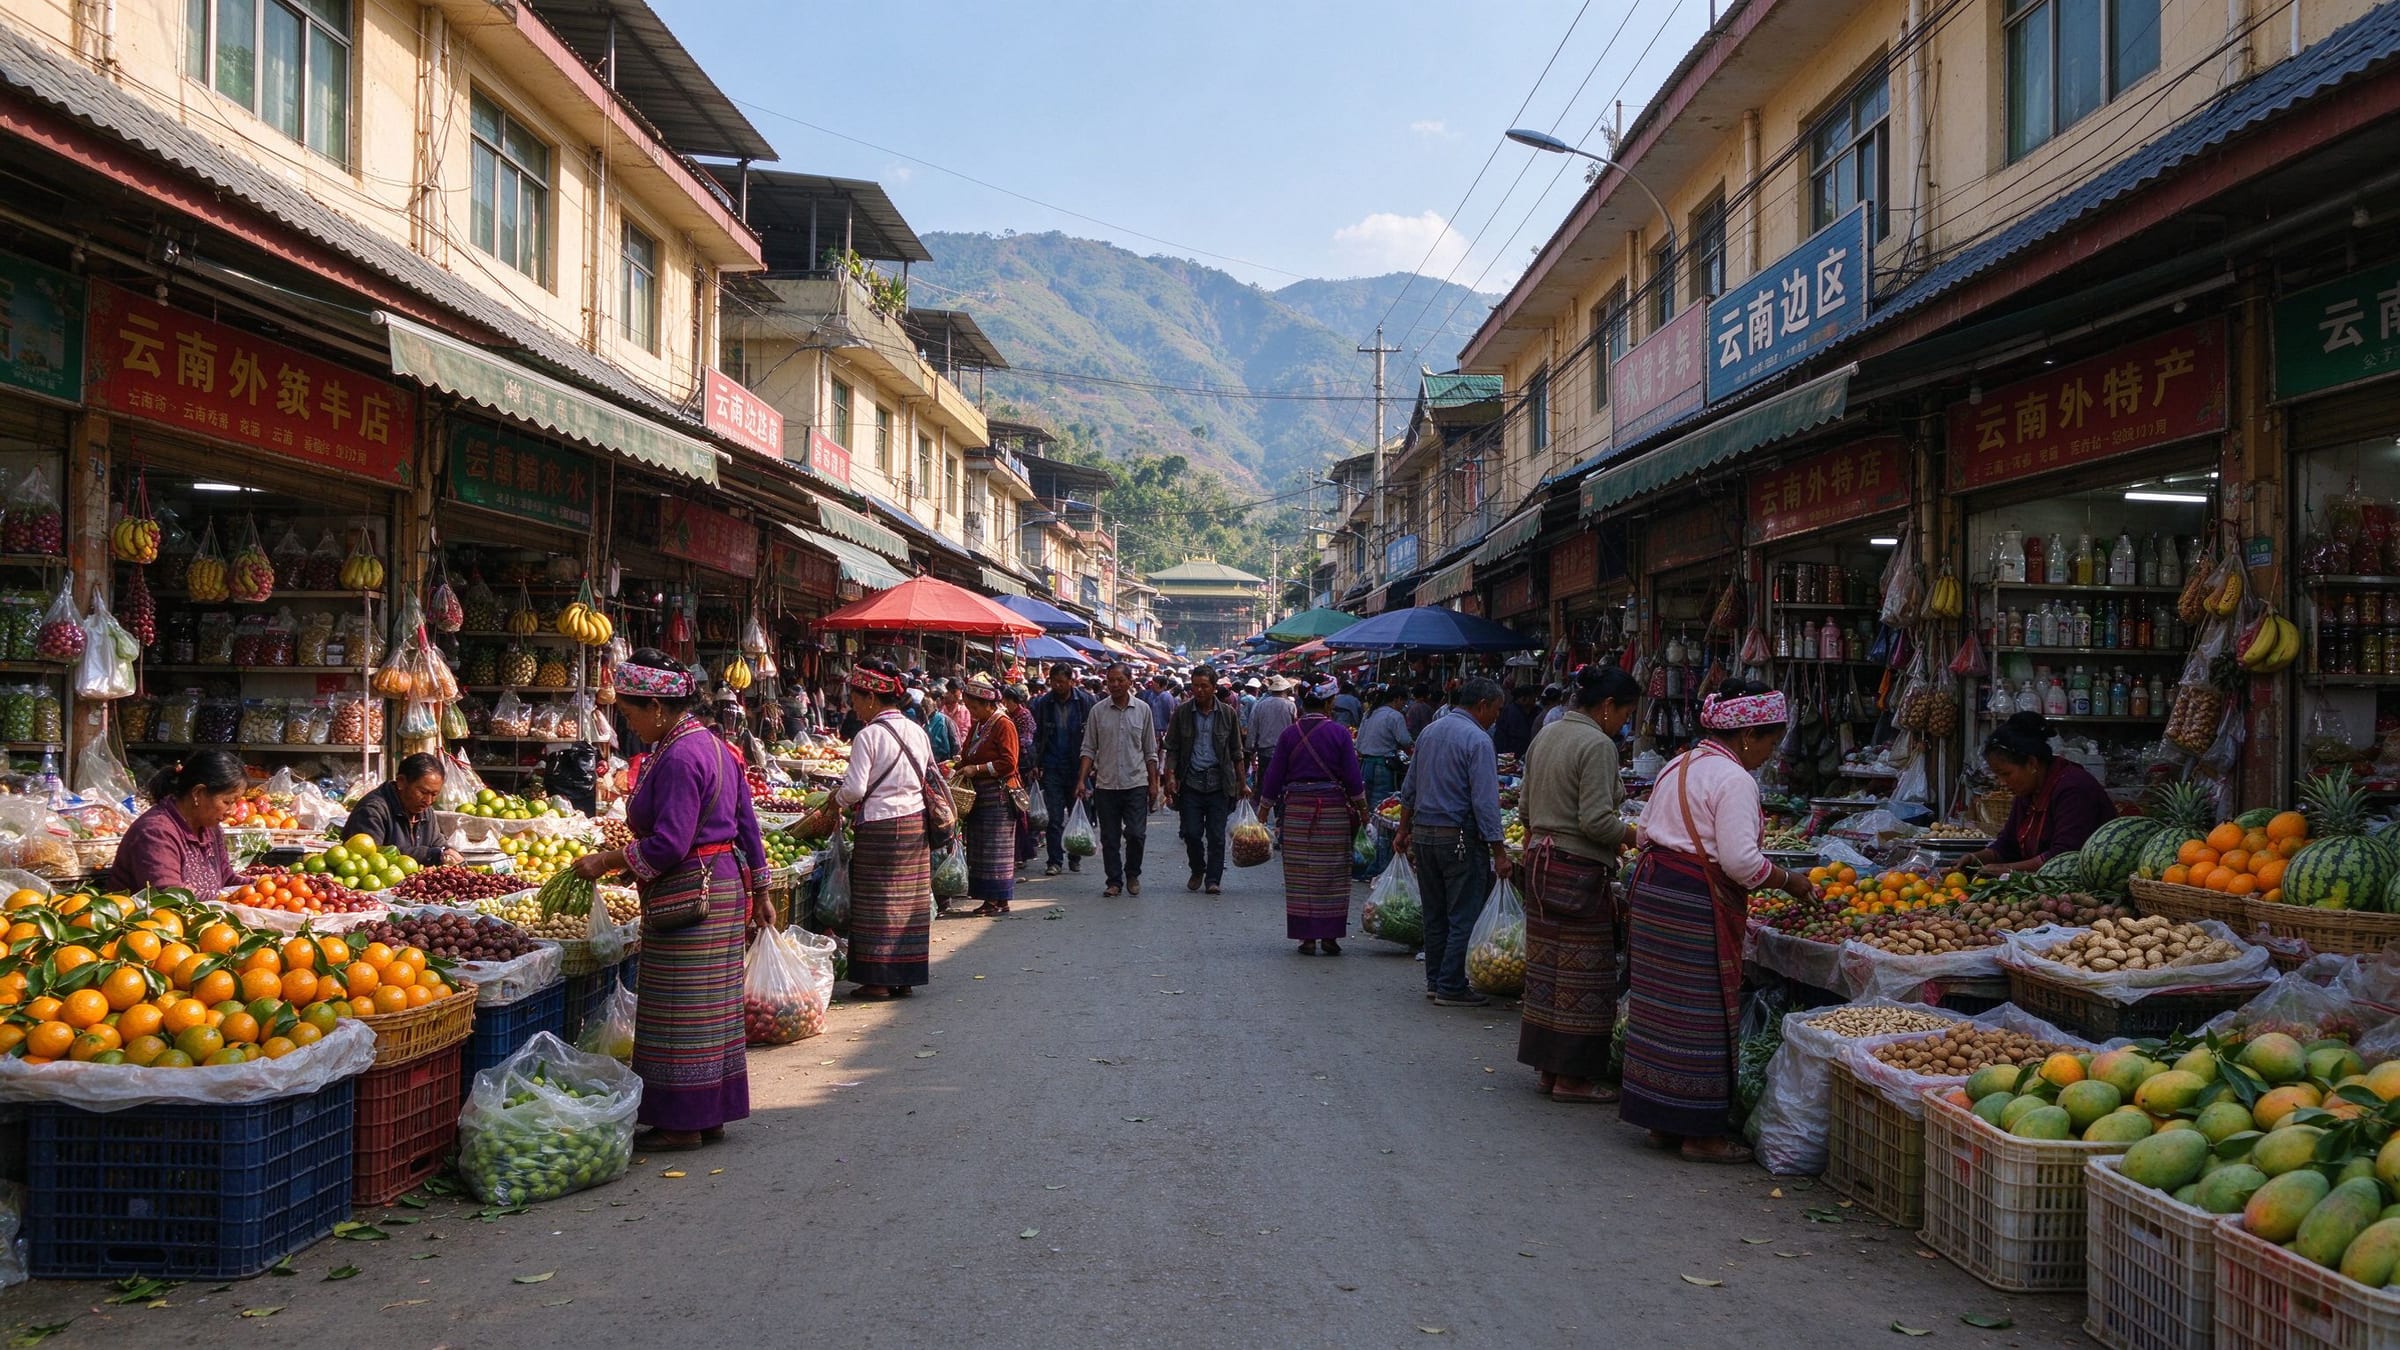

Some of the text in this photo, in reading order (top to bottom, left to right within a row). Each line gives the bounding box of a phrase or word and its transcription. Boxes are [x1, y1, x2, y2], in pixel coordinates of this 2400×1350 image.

[1718, 247, 1847, 369] 云南边区
[1975, 346, 2196, 453] 云南外特产
[1759, 448, 1883, 517] 云南外特店
